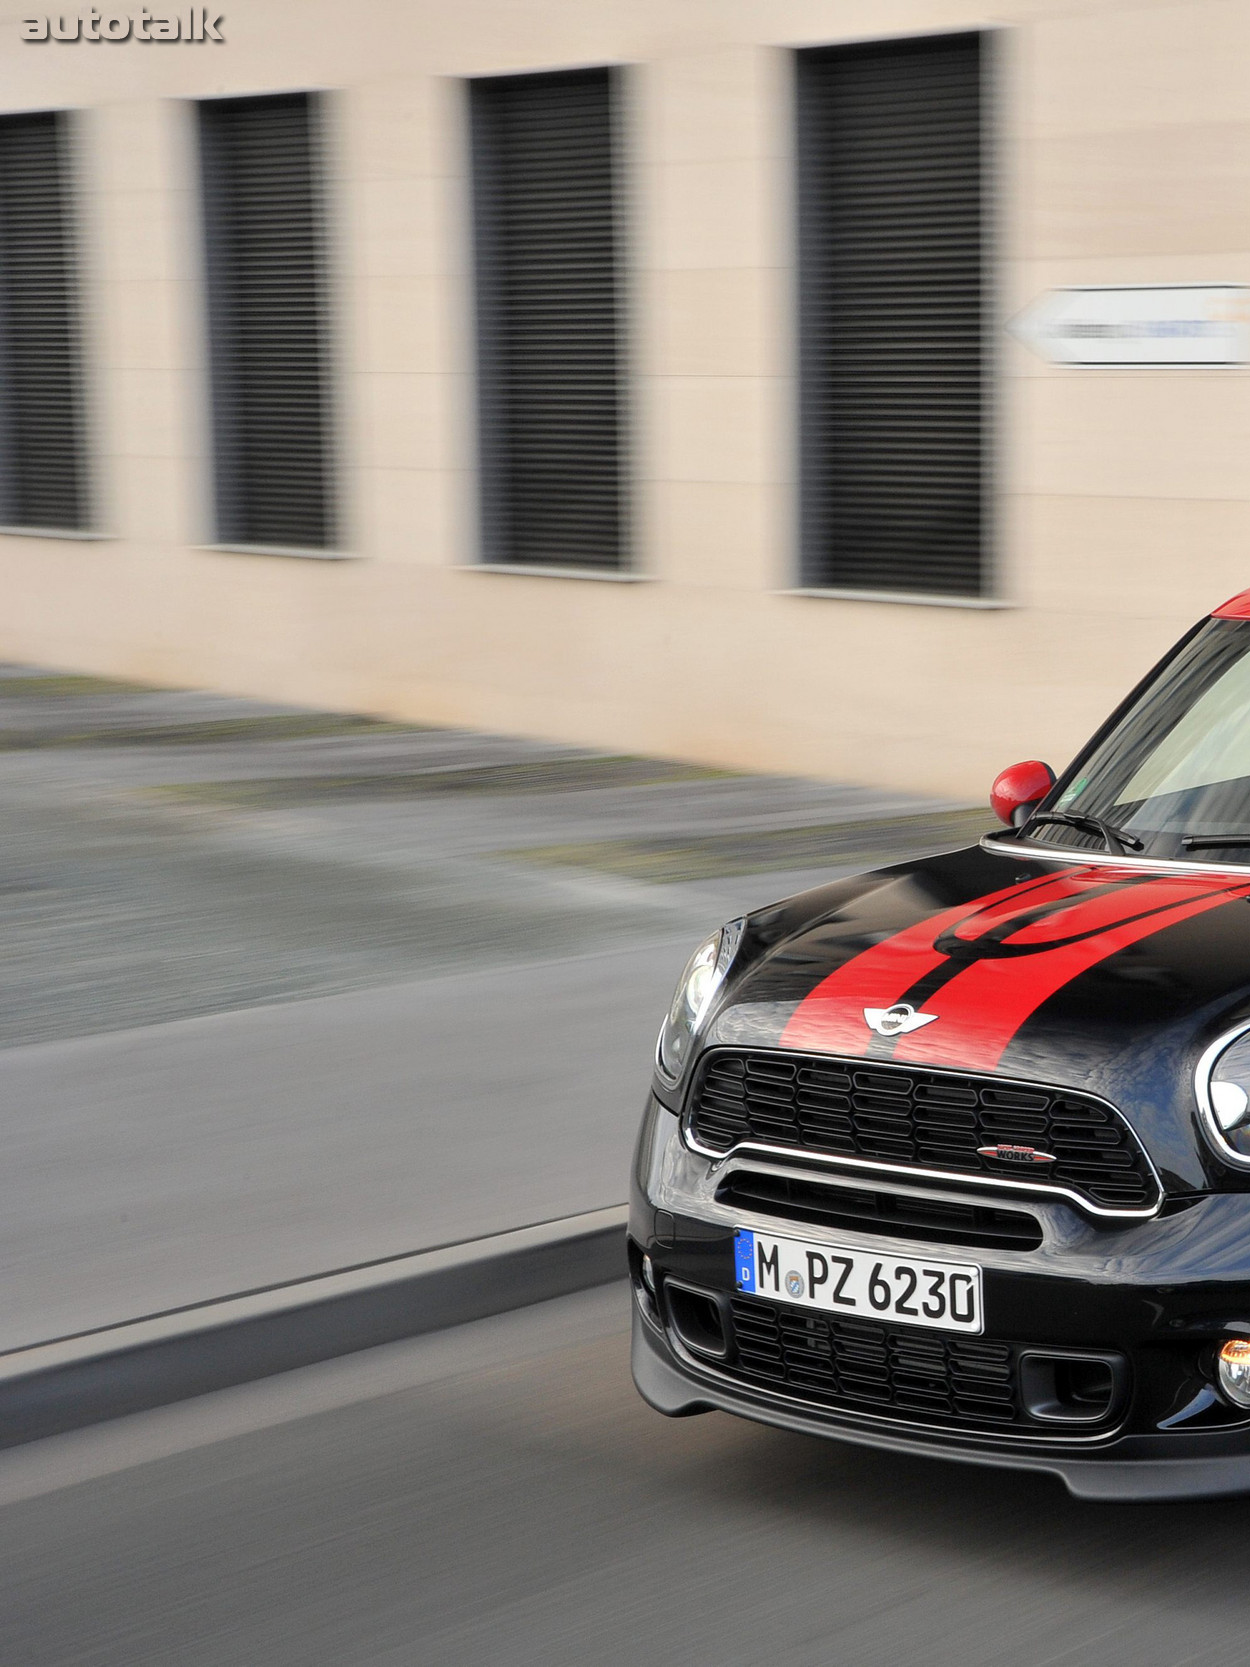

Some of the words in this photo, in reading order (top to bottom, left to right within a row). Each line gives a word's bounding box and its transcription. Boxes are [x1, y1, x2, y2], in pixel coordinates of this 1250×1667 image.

[997, 1150, 1035, 1162] WORKS
[742, 1267, 750, 1281] D
[757, 1240, 780, 1292] M
[806, 1251, 856, 1306] PZ
[868, 1262, 975, 1323] 6230
